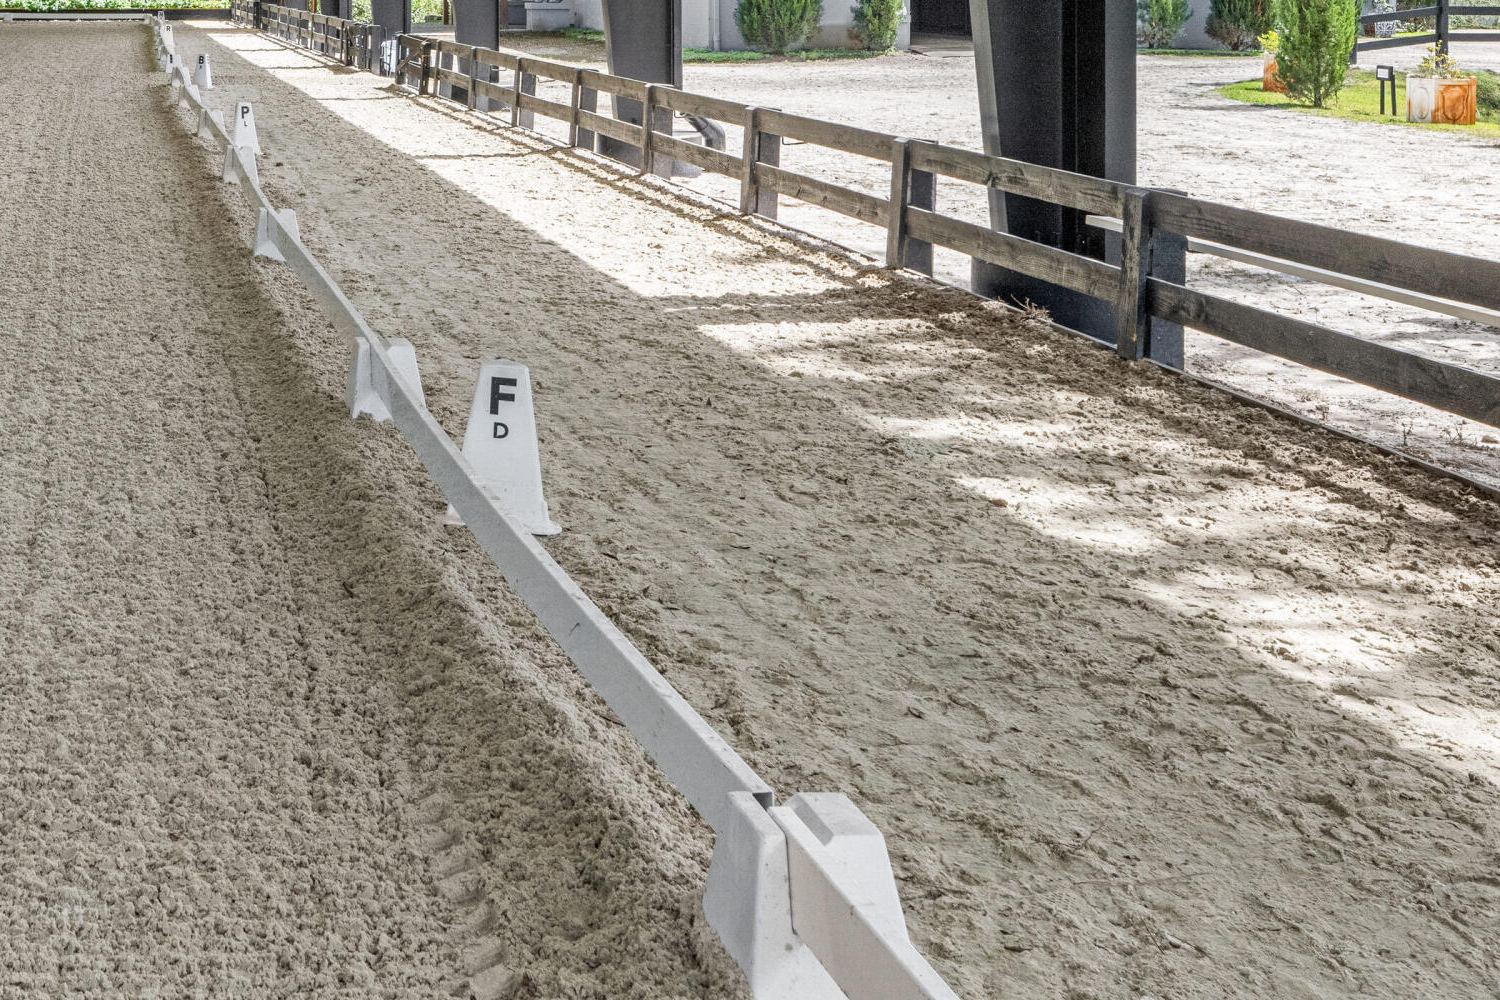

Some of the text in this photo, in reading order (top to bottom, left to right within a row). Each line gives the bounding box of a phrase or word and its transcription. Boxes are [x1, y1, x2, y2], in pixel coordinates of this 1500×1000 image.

[198, 55, 205, 65] B
[241, 106, 250, 120] P
[490, 376, 517, 415] F
[493, 421, 509, 439] D
